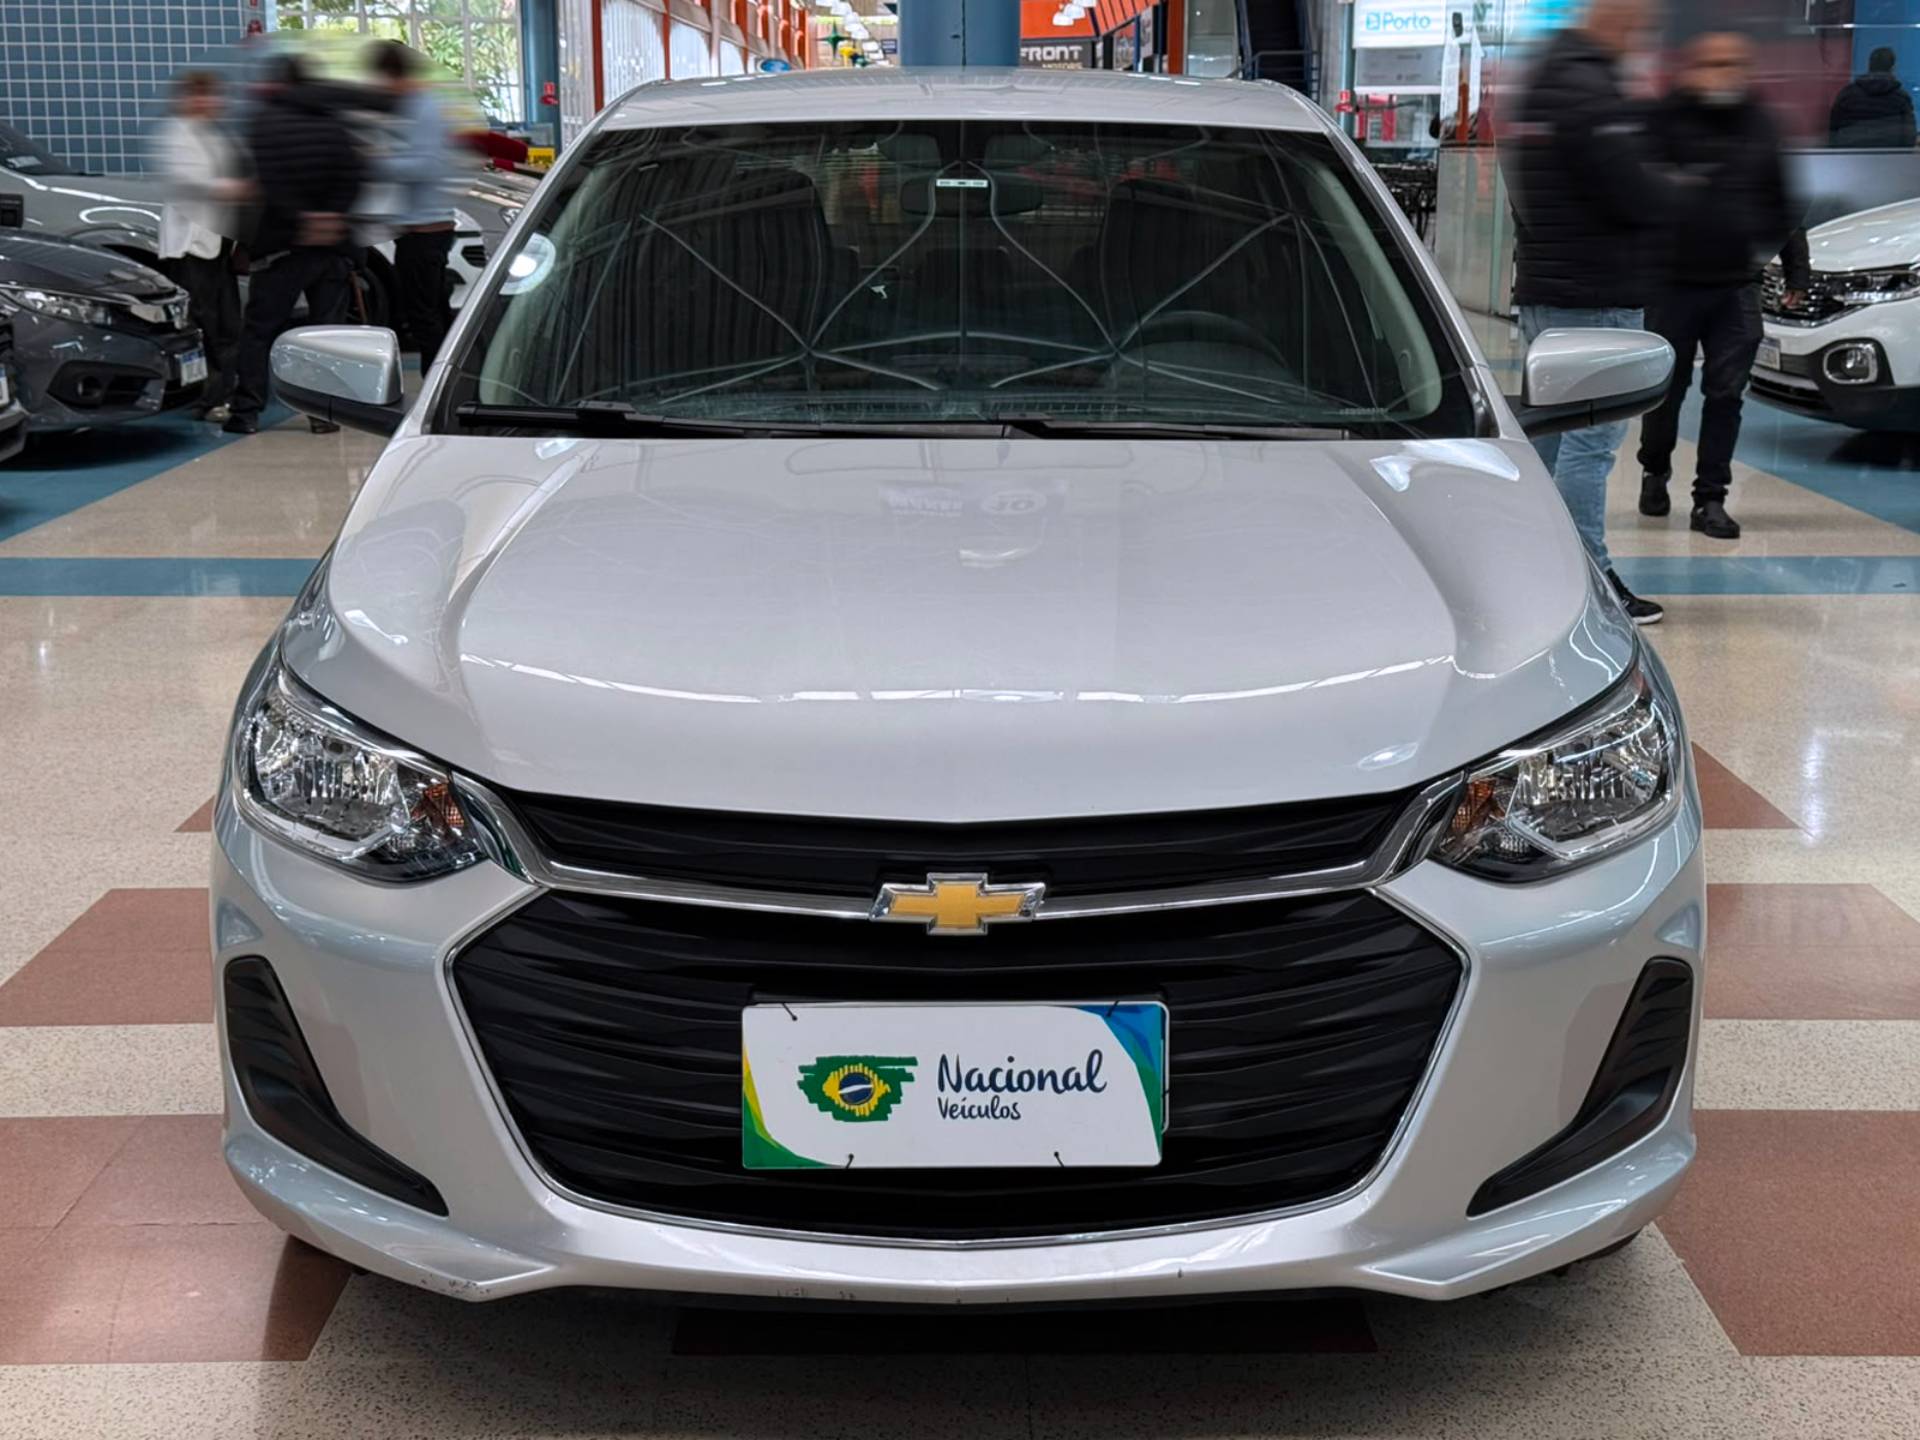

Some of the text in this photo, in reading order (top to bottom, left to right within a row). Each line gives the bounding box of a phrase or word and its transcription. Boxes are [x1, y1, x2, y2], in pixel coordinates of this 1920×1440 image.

[1382, 11, 1431, 30] Porto
[1020, 45, 1083, 61] FRONT
[937, 1049, 1107, 1095] Nacional
[937, 1095, 1022, 1121] Veículos
